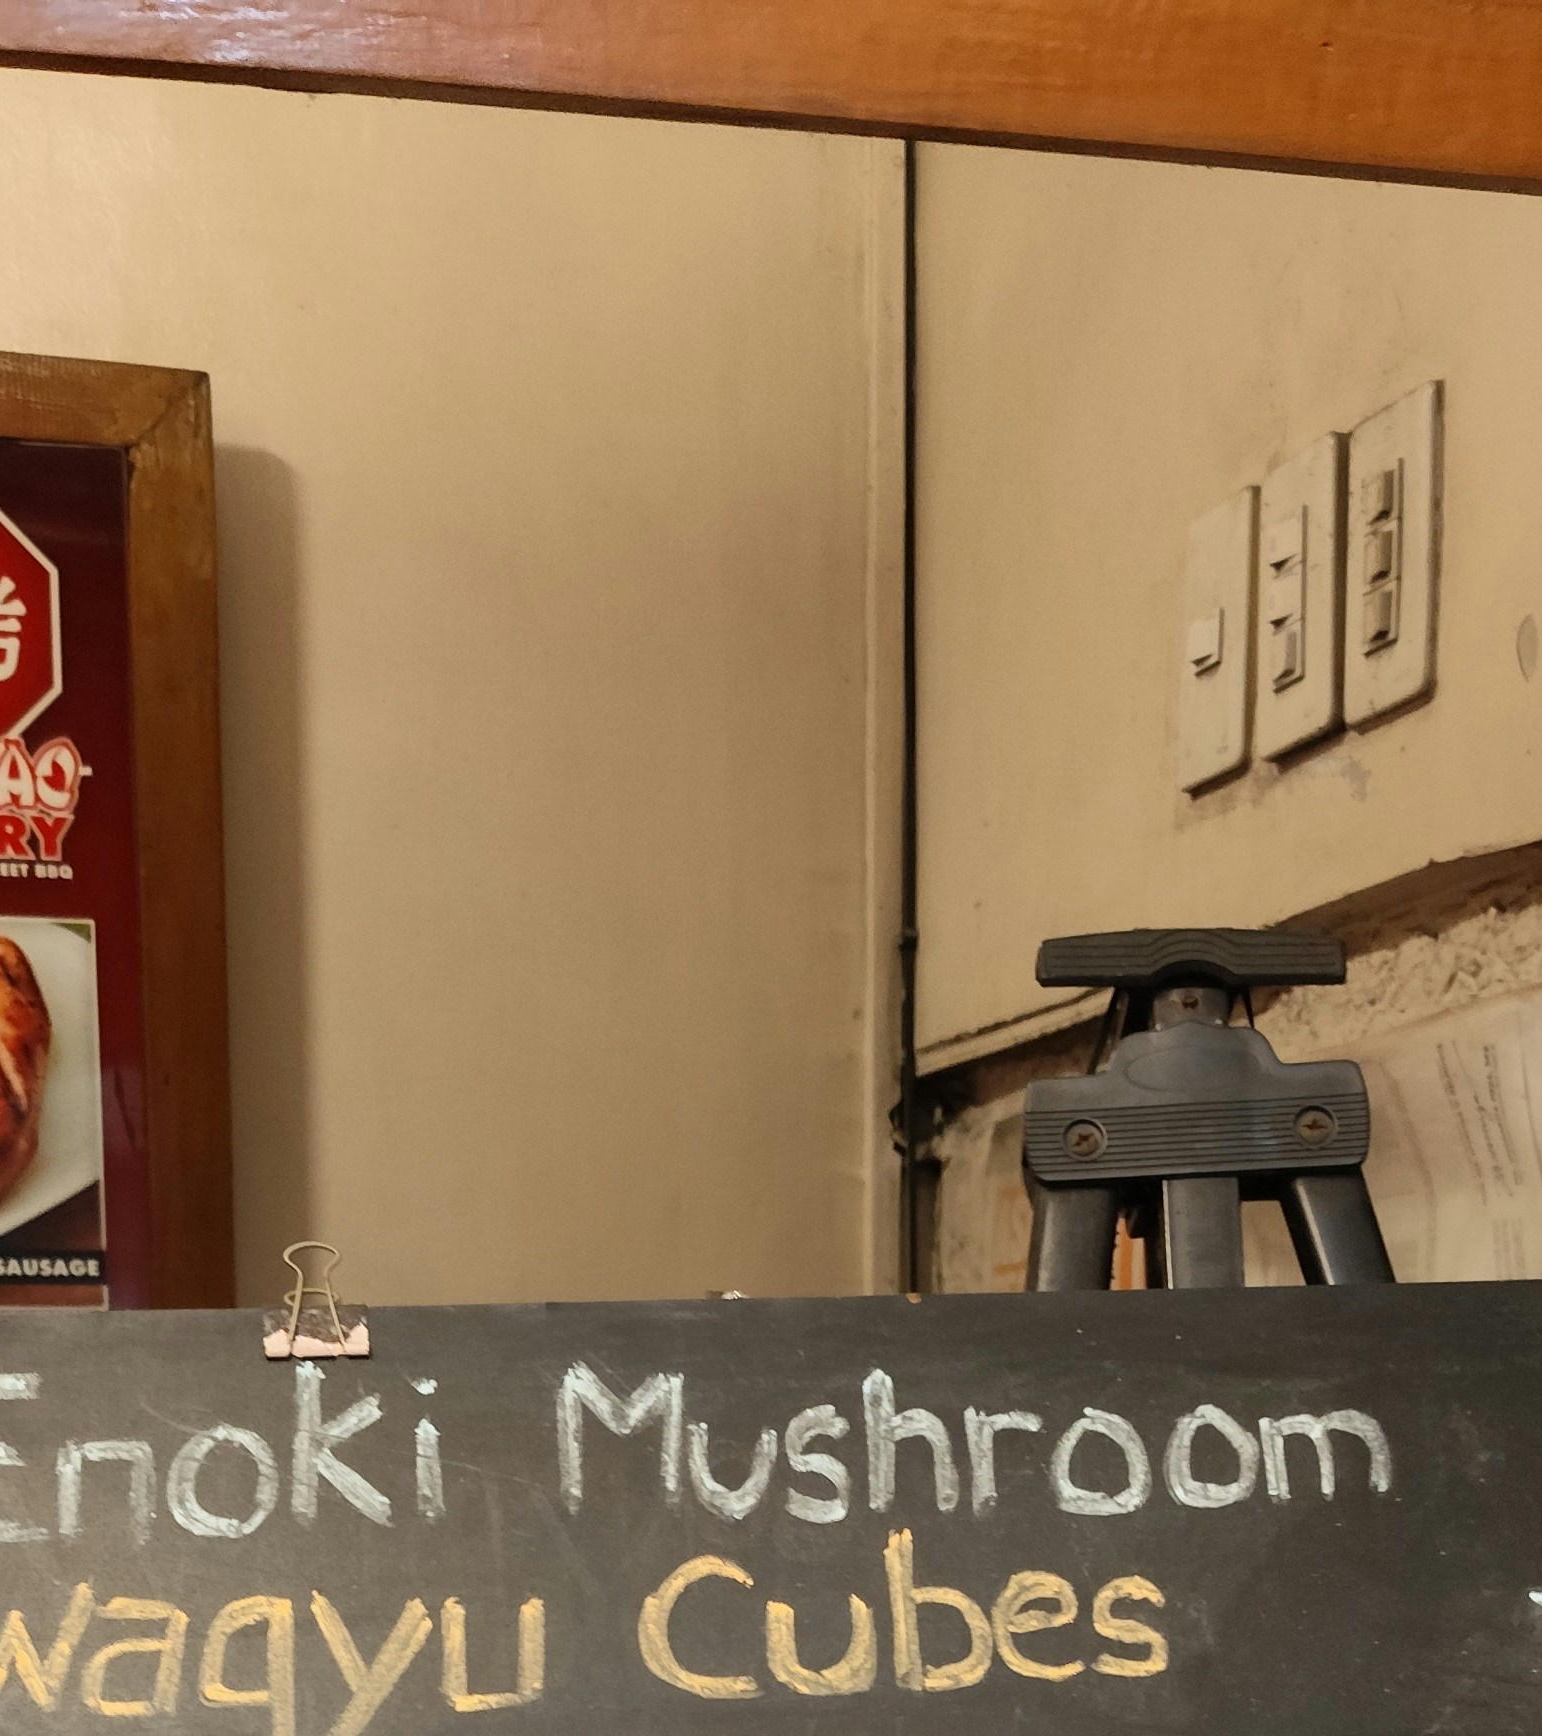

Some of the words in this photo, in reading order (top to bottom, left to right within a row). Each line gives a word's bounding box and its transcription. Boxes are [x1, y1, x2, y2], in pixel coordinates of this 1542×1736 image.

[34, 863, 74, 880] BBQ
[556, 1358, 1392, 1524] Mushroom
[637, 1527, 1171, 1700] Cubes
